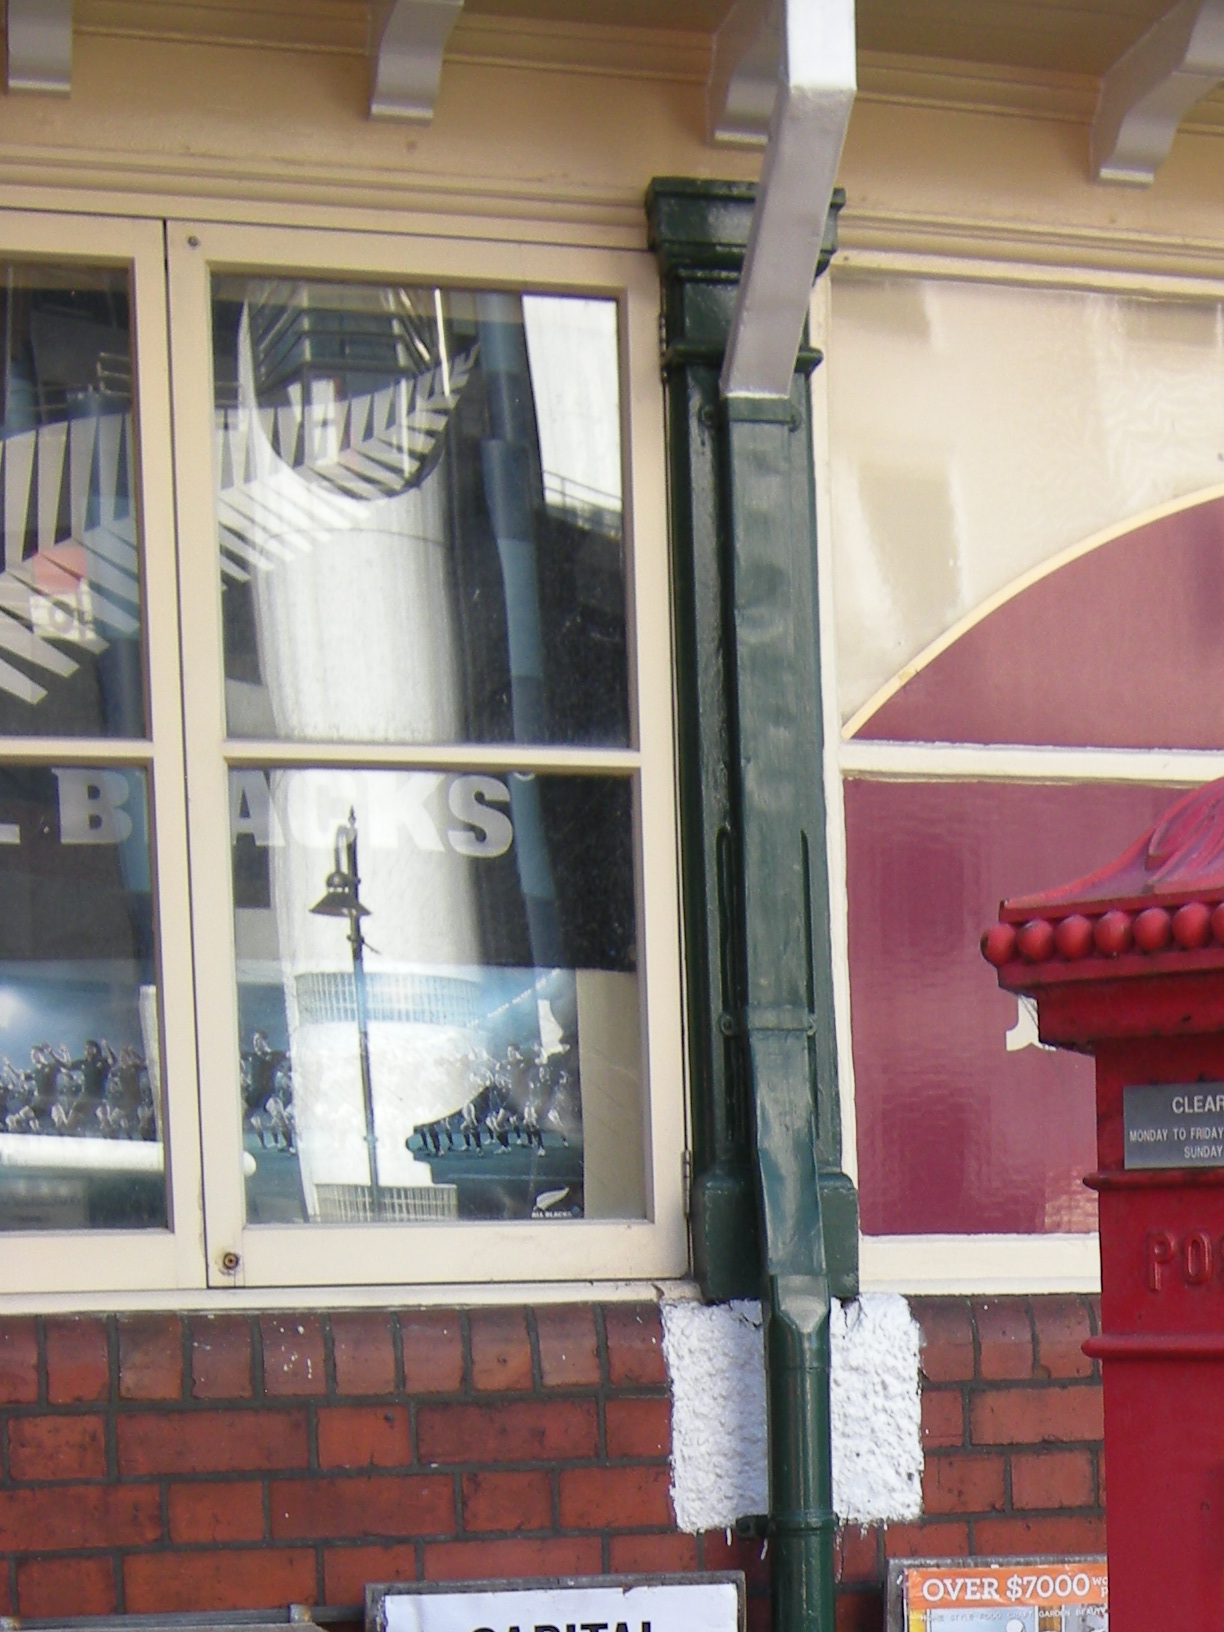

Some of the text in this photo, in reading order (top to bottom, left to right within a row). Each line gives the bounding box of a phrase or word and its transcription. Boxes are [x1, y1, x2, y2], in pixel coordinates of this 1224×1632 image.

[52, 767, 513, 858] BACKS
[1129, 1127, 1168, 1142] MONDAY
[1173, 1127, 1187, 1140] TO
[1190, 1126, 1224, 1139] FRIDAY
[1184, 1145, 1223, 1159] SUNDAY
[922, 1576, 1000, 1602] OVER
[1006, 1573, 1091, 1601] $7000
